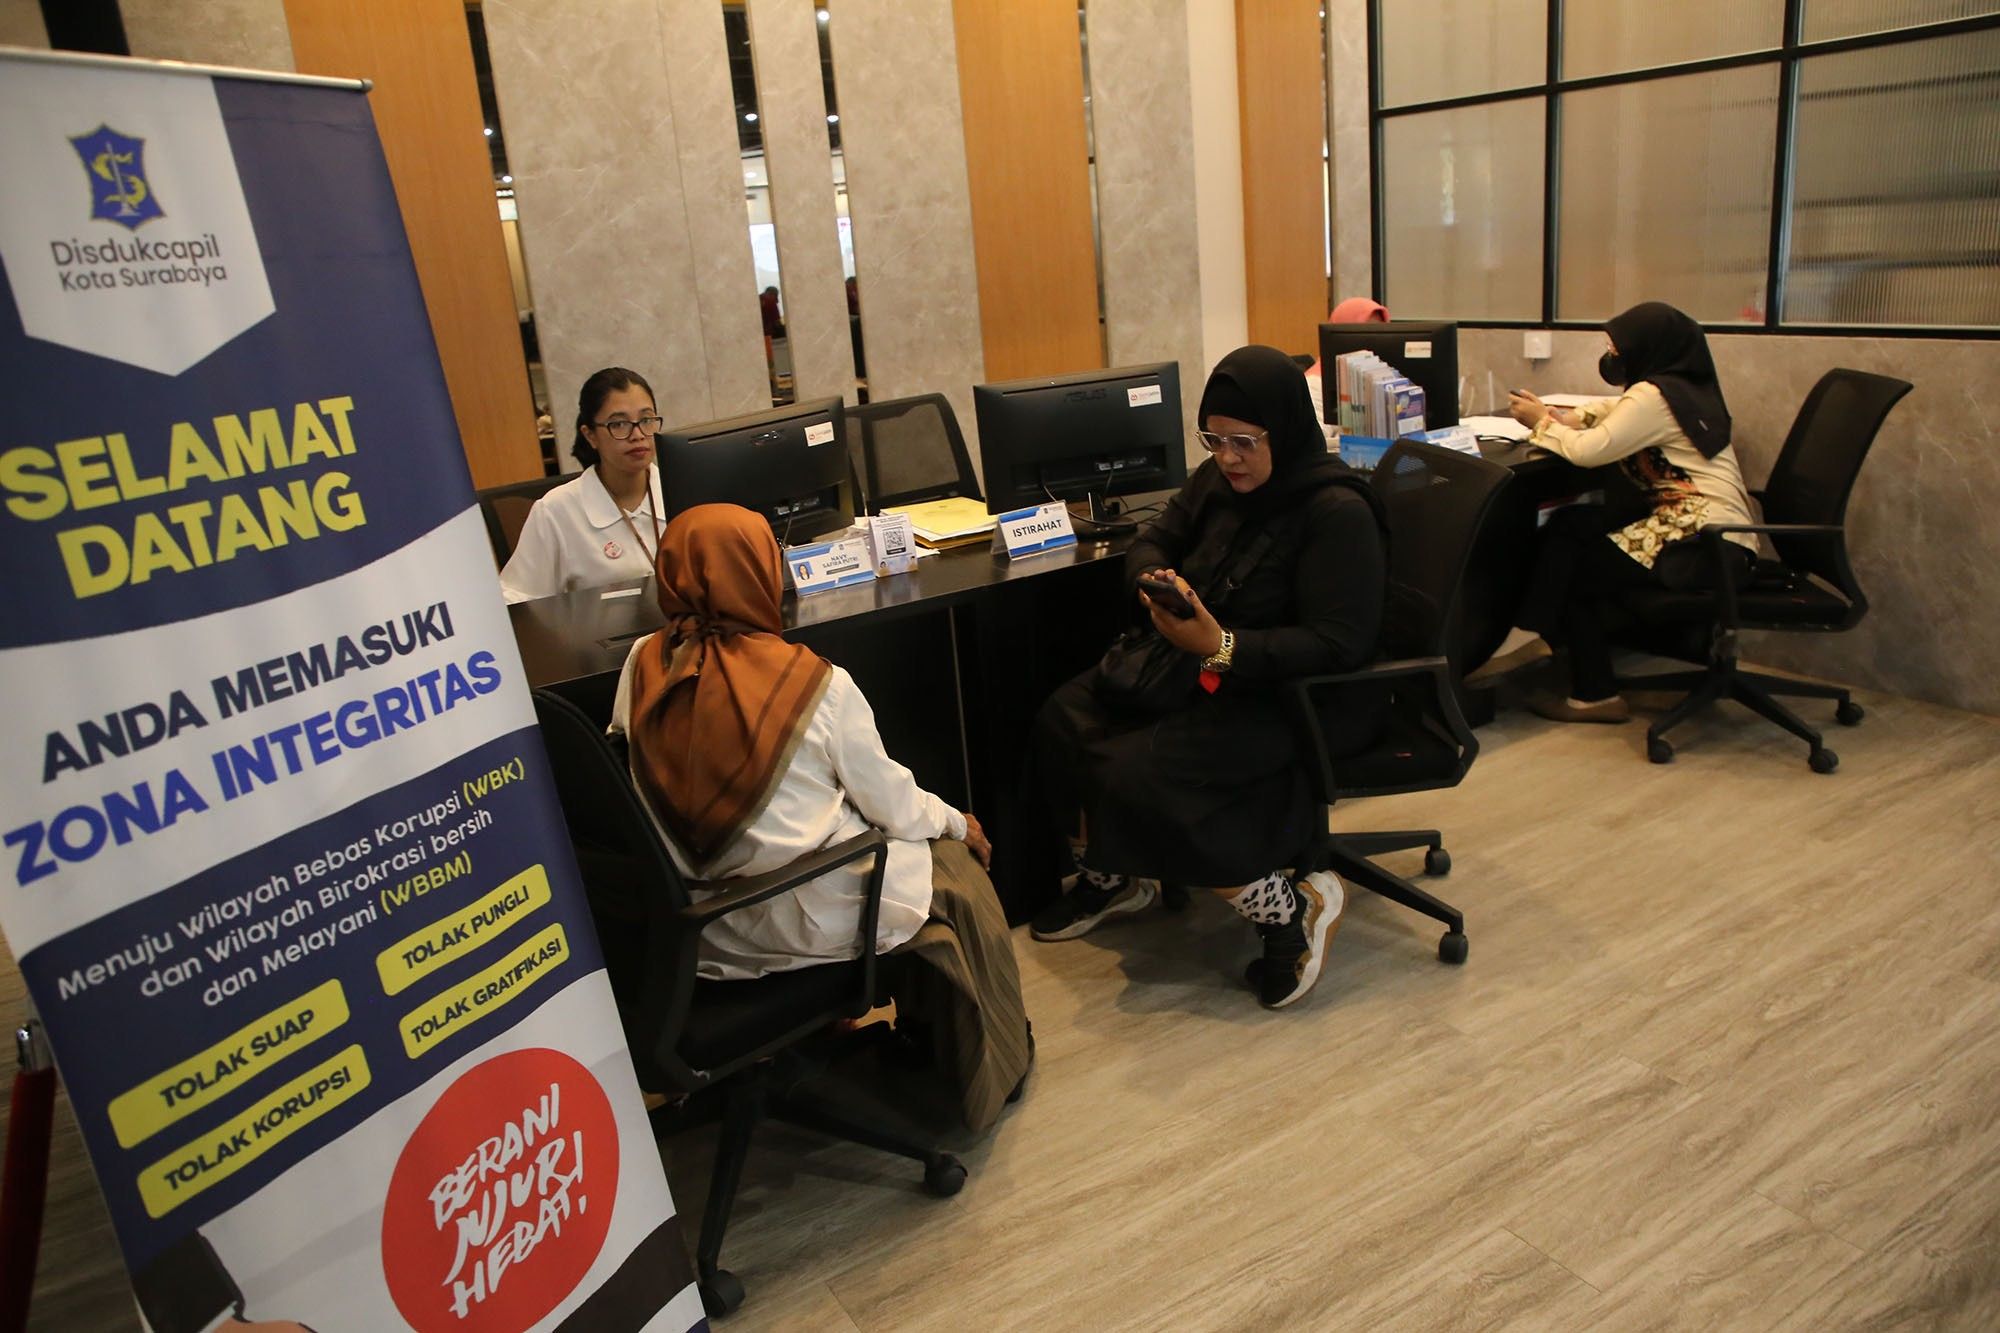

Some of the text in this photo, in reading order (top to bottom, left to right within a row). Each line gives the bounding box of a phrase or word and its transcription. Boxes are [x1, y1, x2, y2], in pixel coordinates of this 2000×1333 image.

[50, 234, 221, 266] Disdukcapil
[59, 264, 227, 291] Kota Surabaya
[0, 396, 357, 521] SELAMAT
[57, 471, 367, 599] DATANG
[1012, 519, 1062, 537] ISTIRAHAT
[42, 601, 456, 783] ANDA MEMASUKI
[3, 651, 501, 886] ZONA INTEGRITAS
[57, 757, 525, 1001] Menuju Wilayah Bebas Korupsi (WBK)
[141, 809, 493, 997] dan Wilayah Birokrasi bersih
[203, 850, 472, 1006] dan Melayani (WBBM)
[402, 885, 529, 969] TOLAK PUNGLI
[410, 938, 561, 1044] TOLAK GRATIFIKASI
[160, 1009, 315, 1108] TOLAK SUAP
[164, 1066, 352, 1190] TOLAK KORUPSI
[428, 1083, 559, 1231] BERANI
